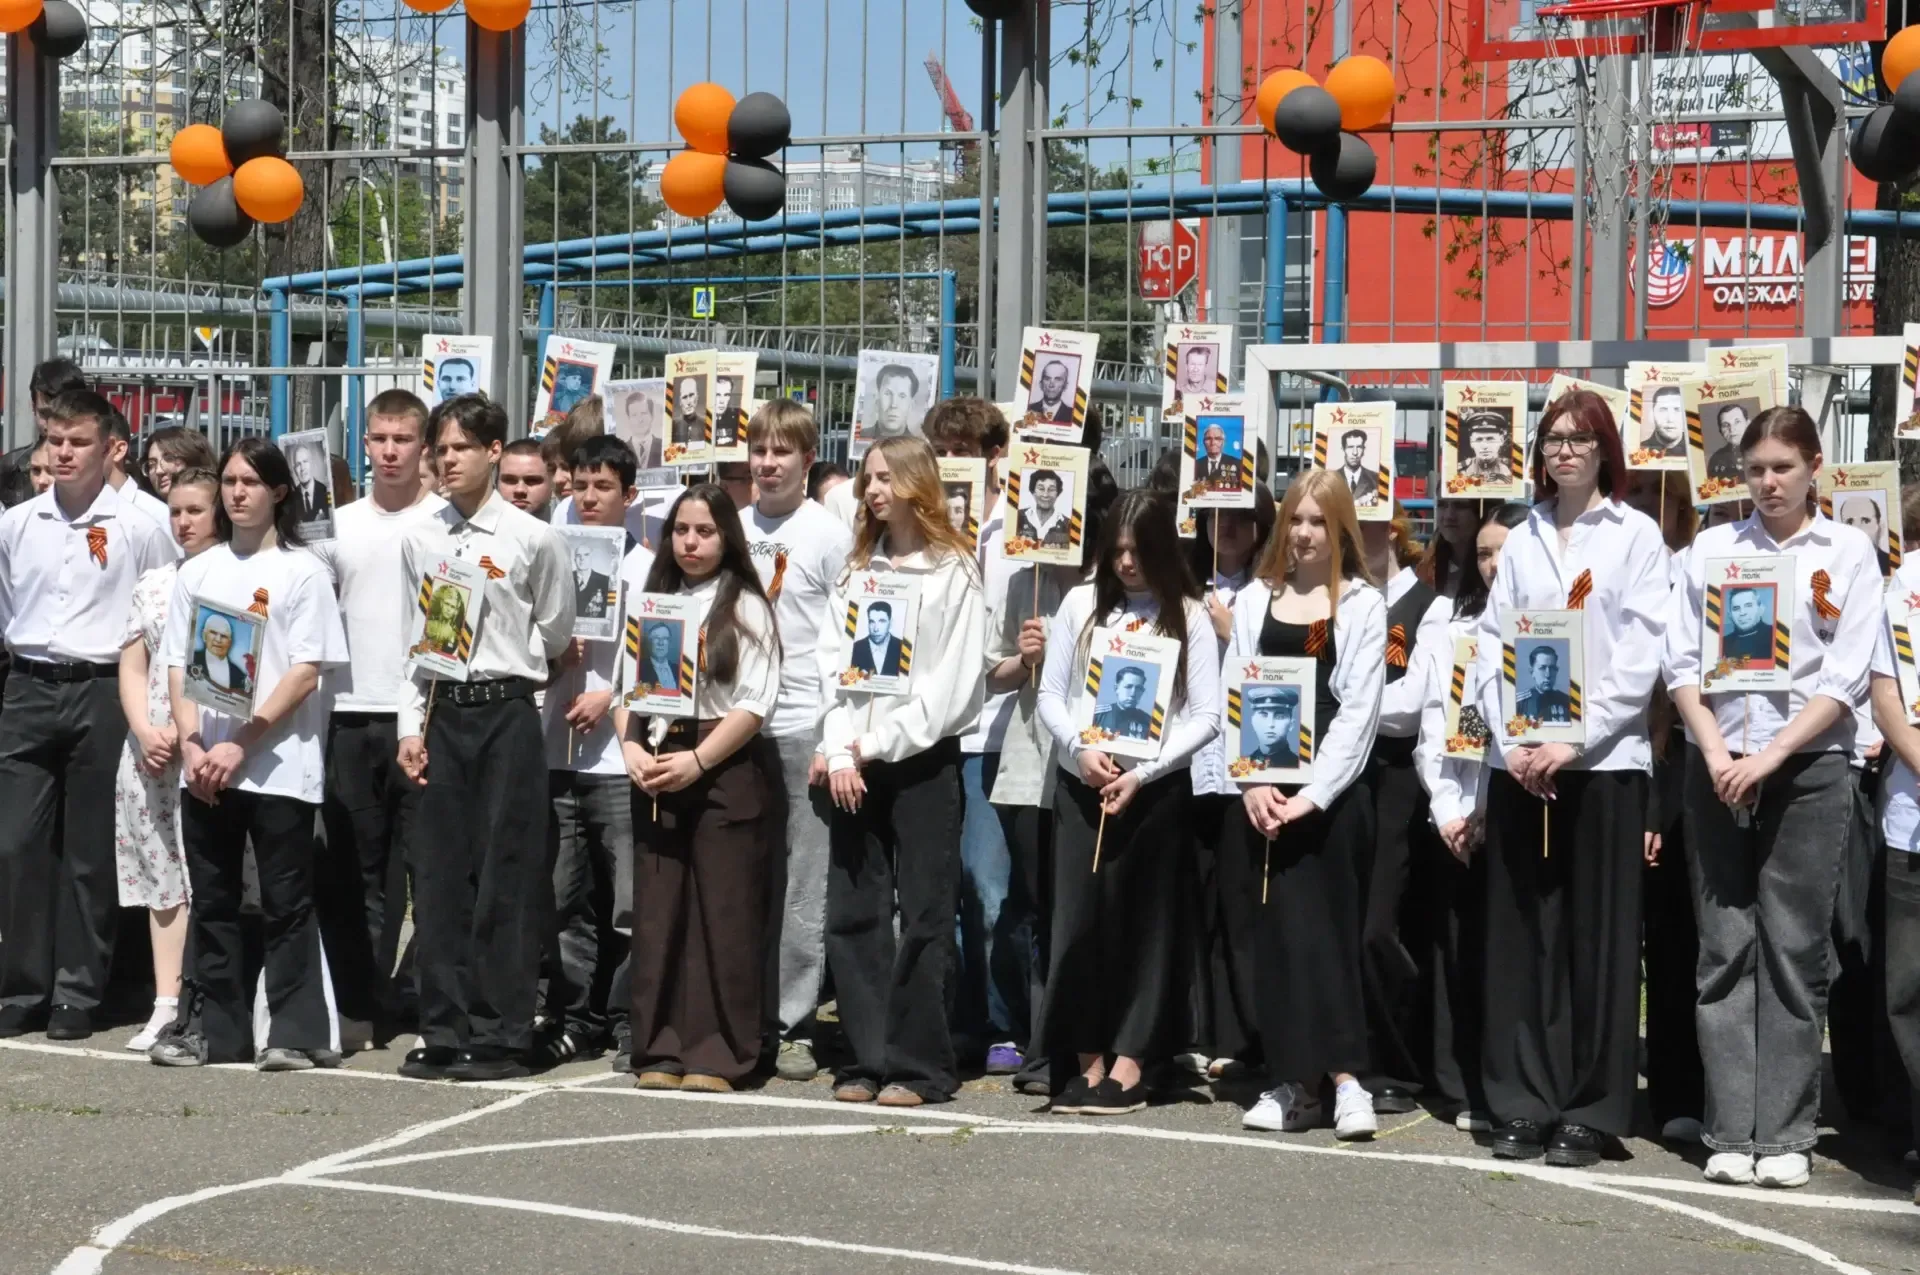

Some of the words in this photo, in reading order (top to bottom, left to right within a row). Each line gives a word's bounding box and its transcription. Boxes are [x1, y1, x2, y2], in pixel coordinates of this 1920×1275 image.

[1713, 284, 1803, 305] ОДЕЖДА
[1718, 389, 1740, 399] ПОЛК
[1850, 479, 1870, 487] ПОЛК
[1741, 572, 1761, 580] ПОЛК
[1533, 627, 1553, 635] ПОЛК
[1125, 648, 1147, 658] ПОЛК
